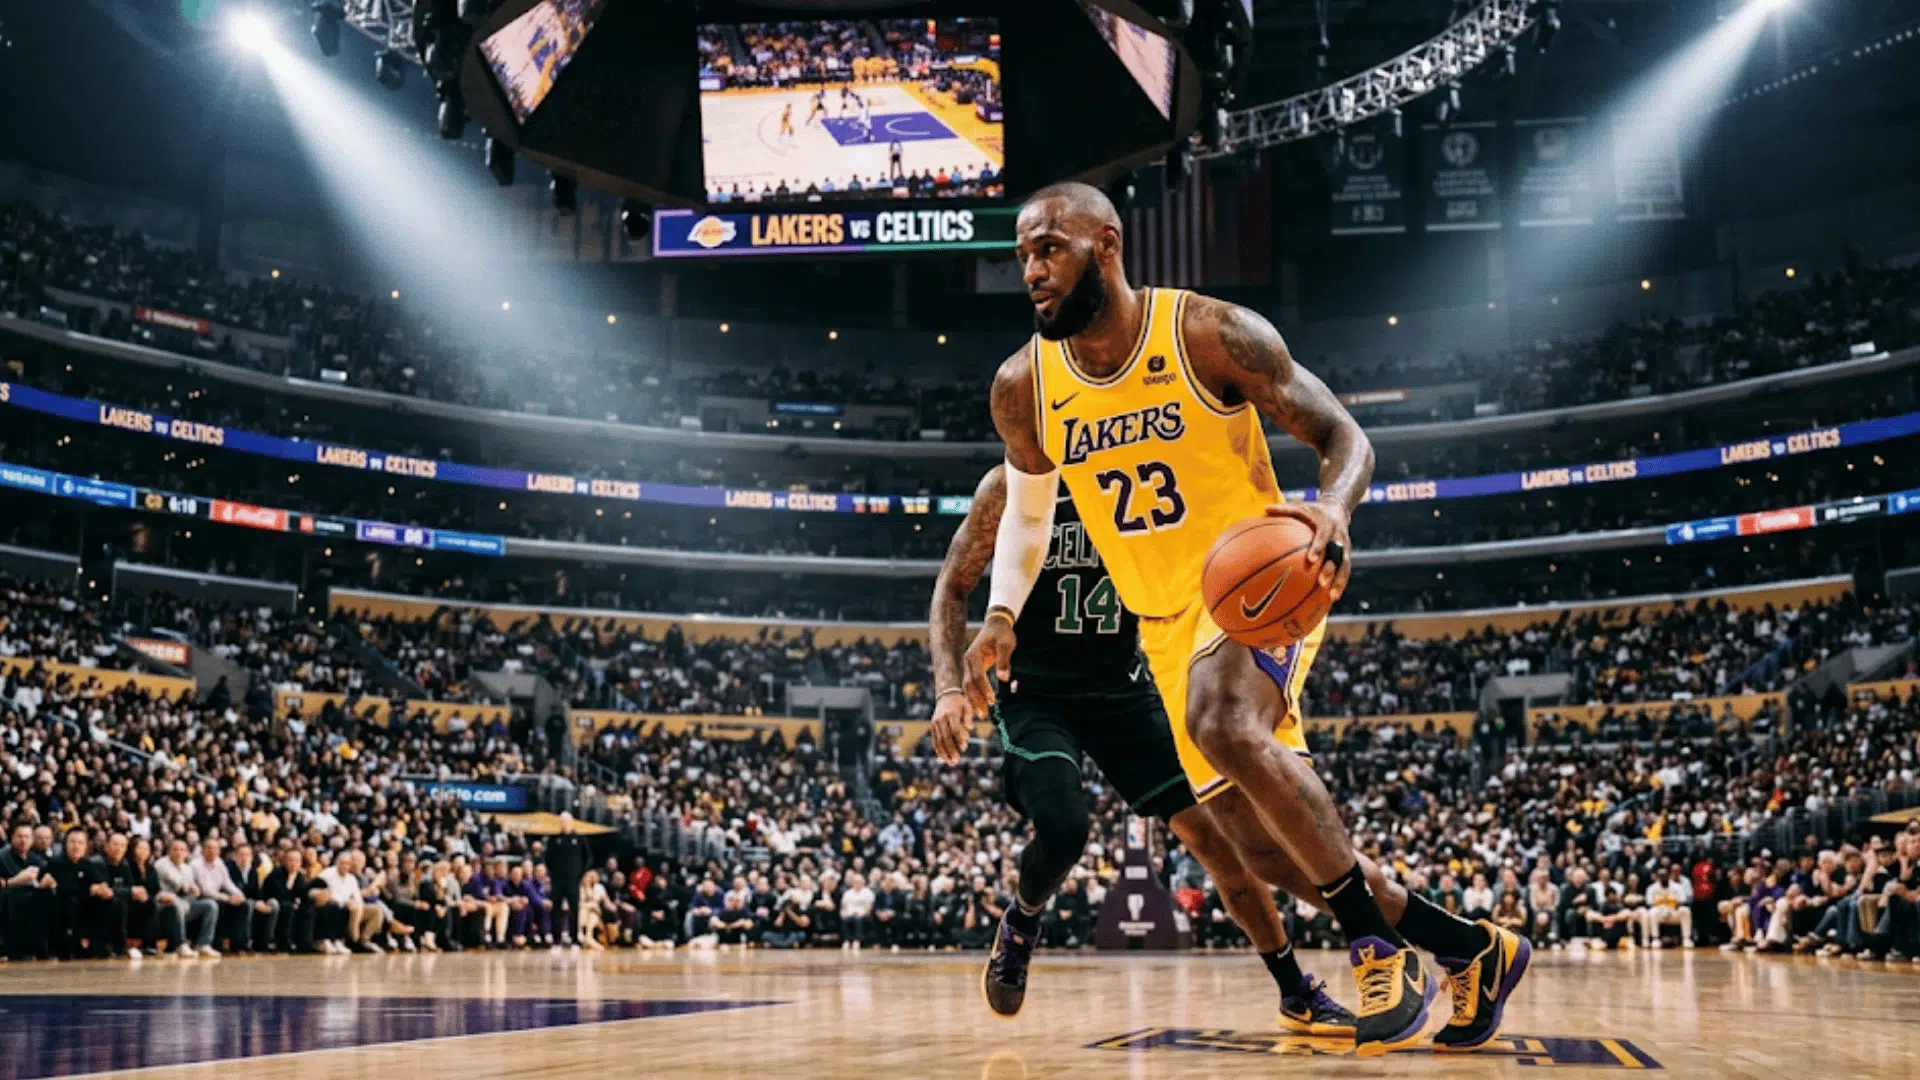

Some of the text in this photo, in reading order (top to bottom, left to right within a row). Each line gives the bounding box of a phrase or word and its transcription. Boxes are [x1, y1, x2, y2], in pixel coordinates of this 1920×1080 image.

[750, 213, 844, 246] LAKERS
[876, 210, 974, 243] CELTICS
[100, 404, 153, 433] LAKERS
[171, 419, 224, 446] CELTICS
[1061, 401, 1186, 465] LAKERS
[1787, 427, 1841, 454] CELTICS
[317, 444, 366, 469] LAKERS
[385, 454, 437, 478] CELTICS
[1585, 459, 1637, 483] CELTICS
[1095, 461, 1188, 536] 23
[1055, 574, 1122, 634] 14
